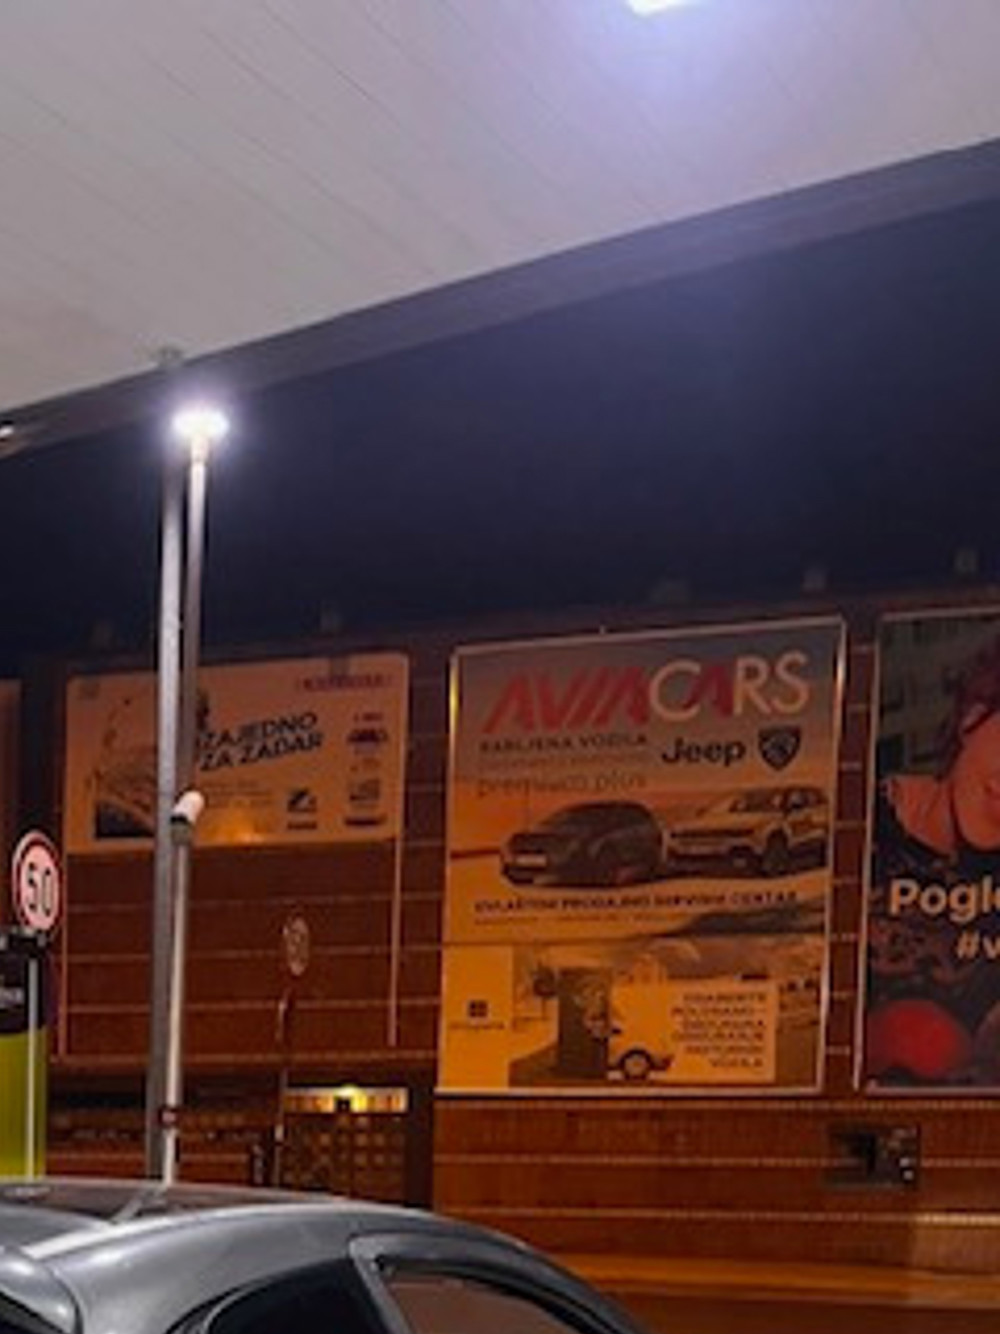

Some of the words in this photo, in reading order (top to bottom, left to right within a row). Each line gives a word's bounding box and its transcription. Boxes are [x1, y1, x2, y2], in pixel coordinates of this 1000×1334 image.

[200, 751, 234, 773] ZA
[240, 731, 325, 765] ZADAR
[661, 736, 748, 767] Jeep
[26, 861, 54, 917] 50
